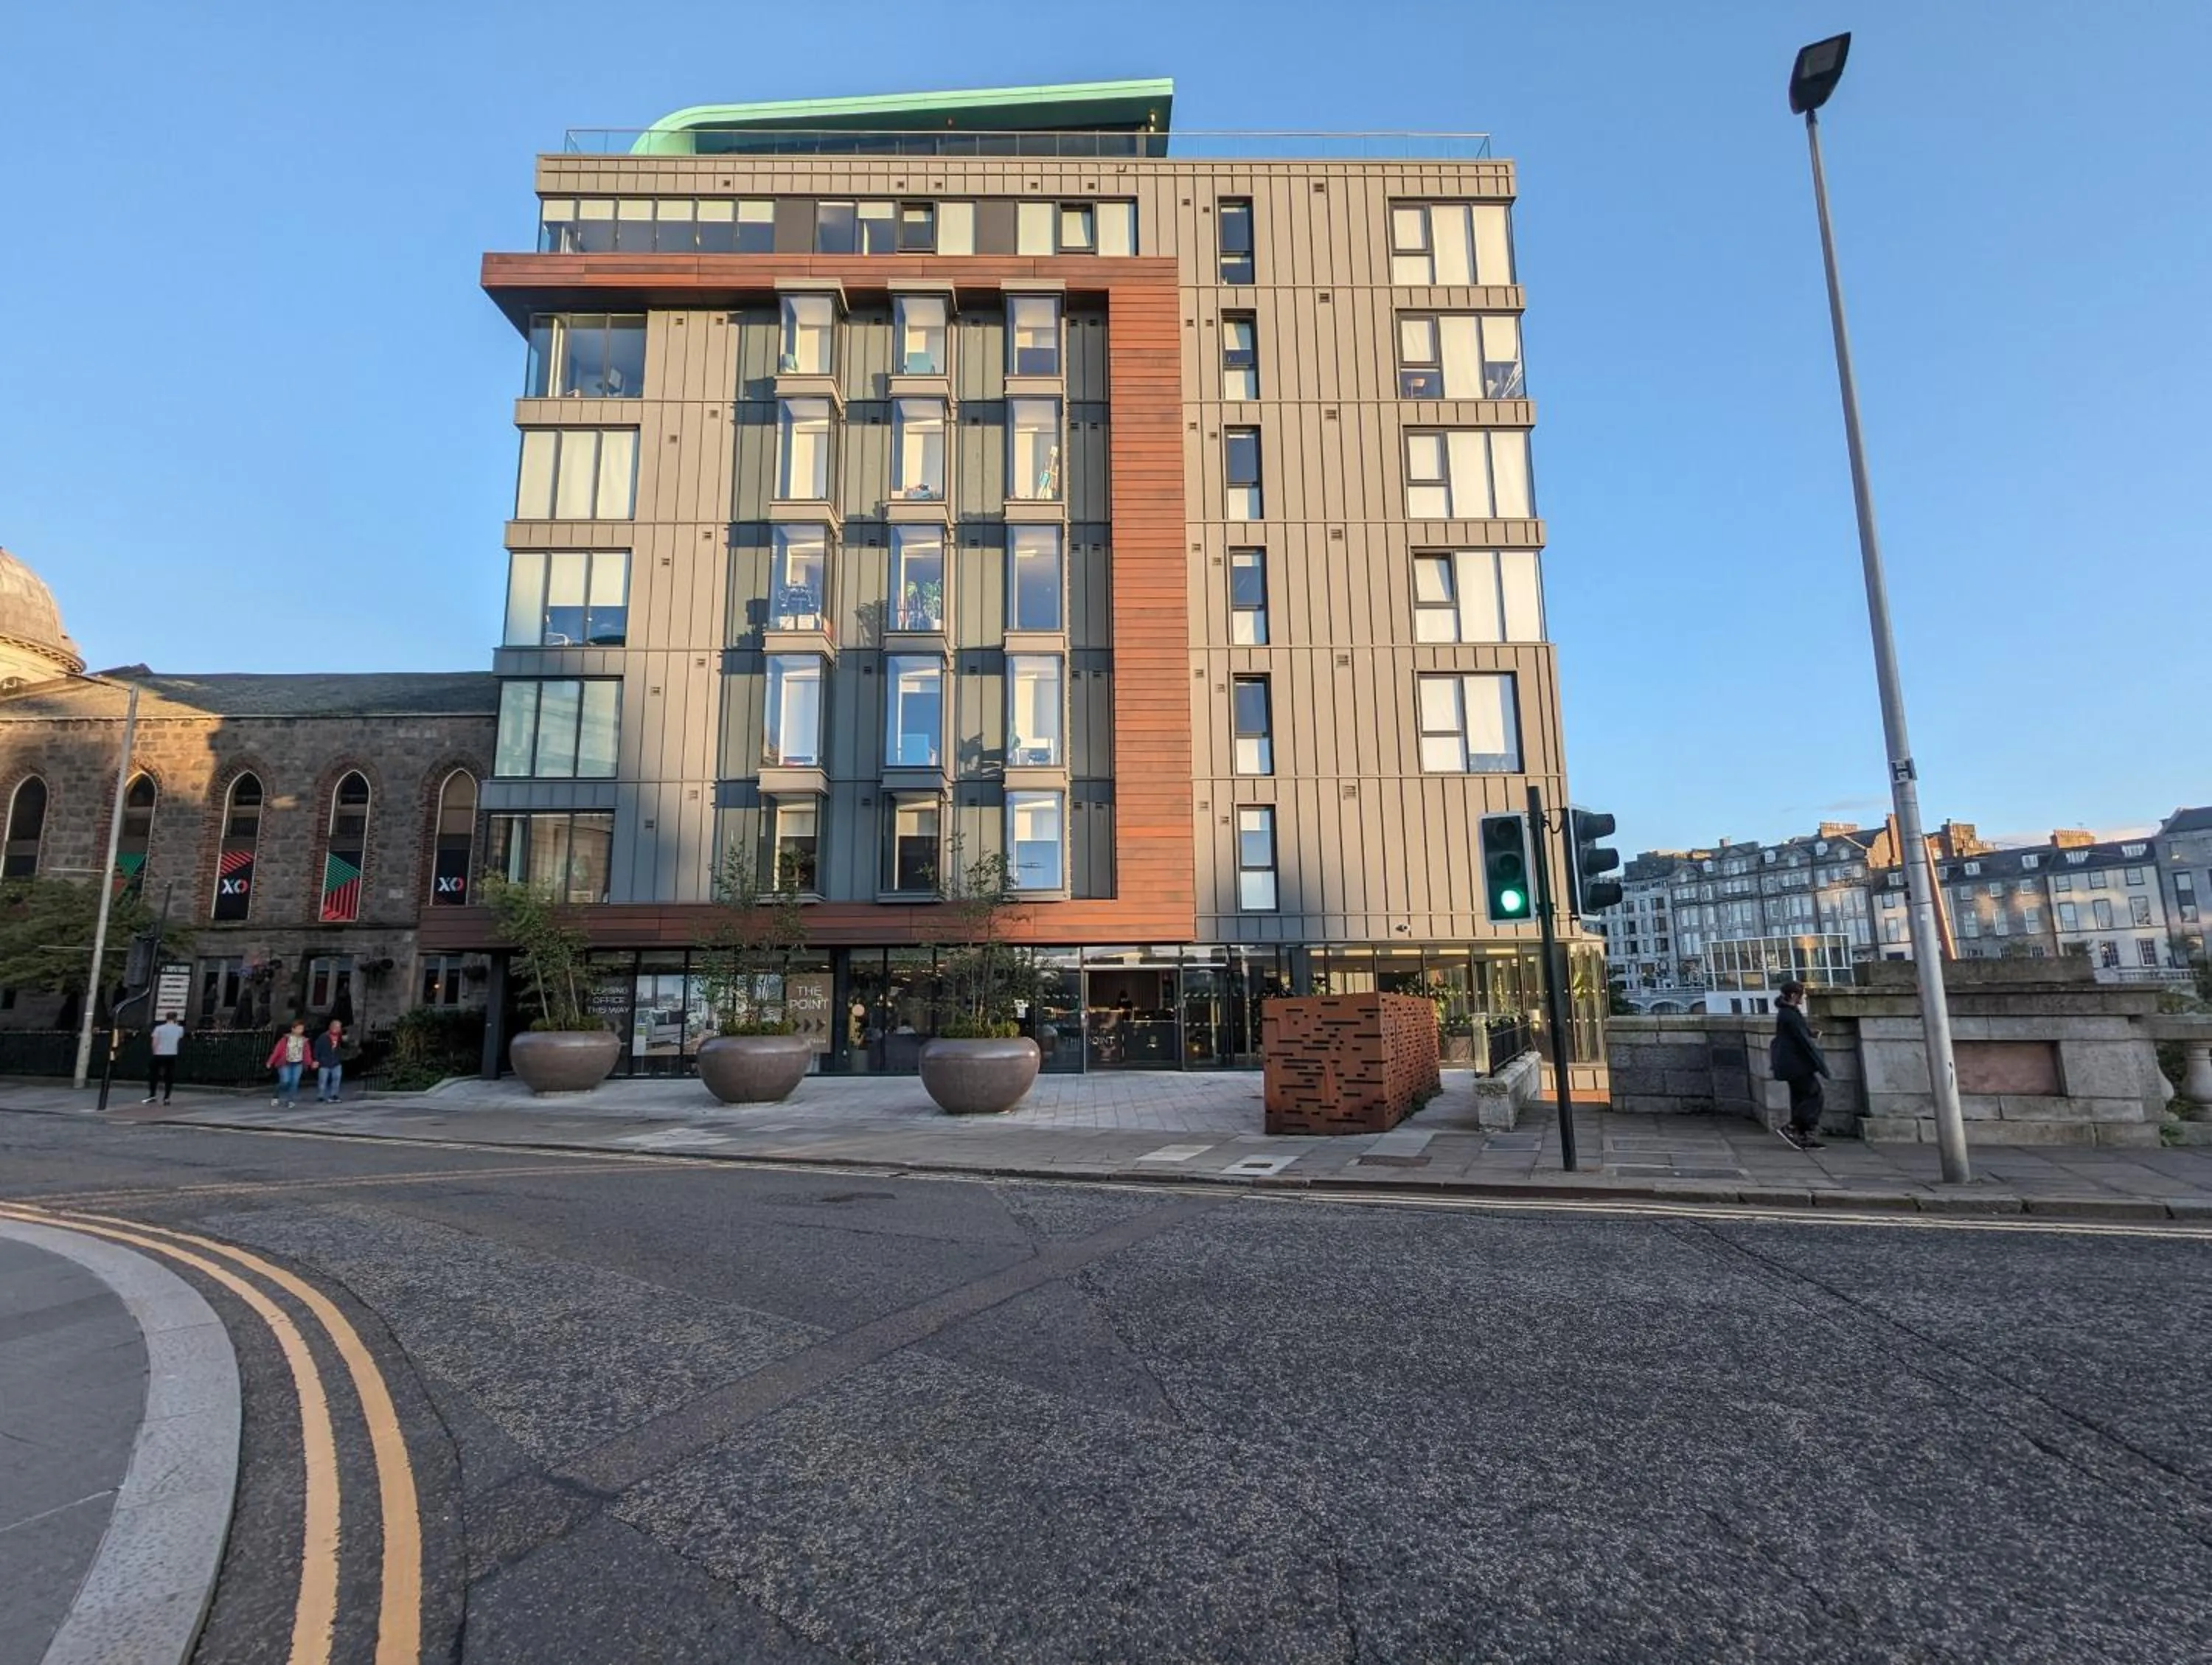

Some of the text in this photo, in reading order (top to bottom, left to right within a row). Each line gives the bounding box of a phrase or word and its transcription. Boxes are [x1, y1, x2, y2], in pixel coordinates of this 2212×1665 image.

[222, 878, 248, 894] XO
[438, 877, 464, 891] XO
[797, 986, 822, 996] THE
[789, 998, 829, 1009] POINT
[608, 1005, 630, 1014] WAY
